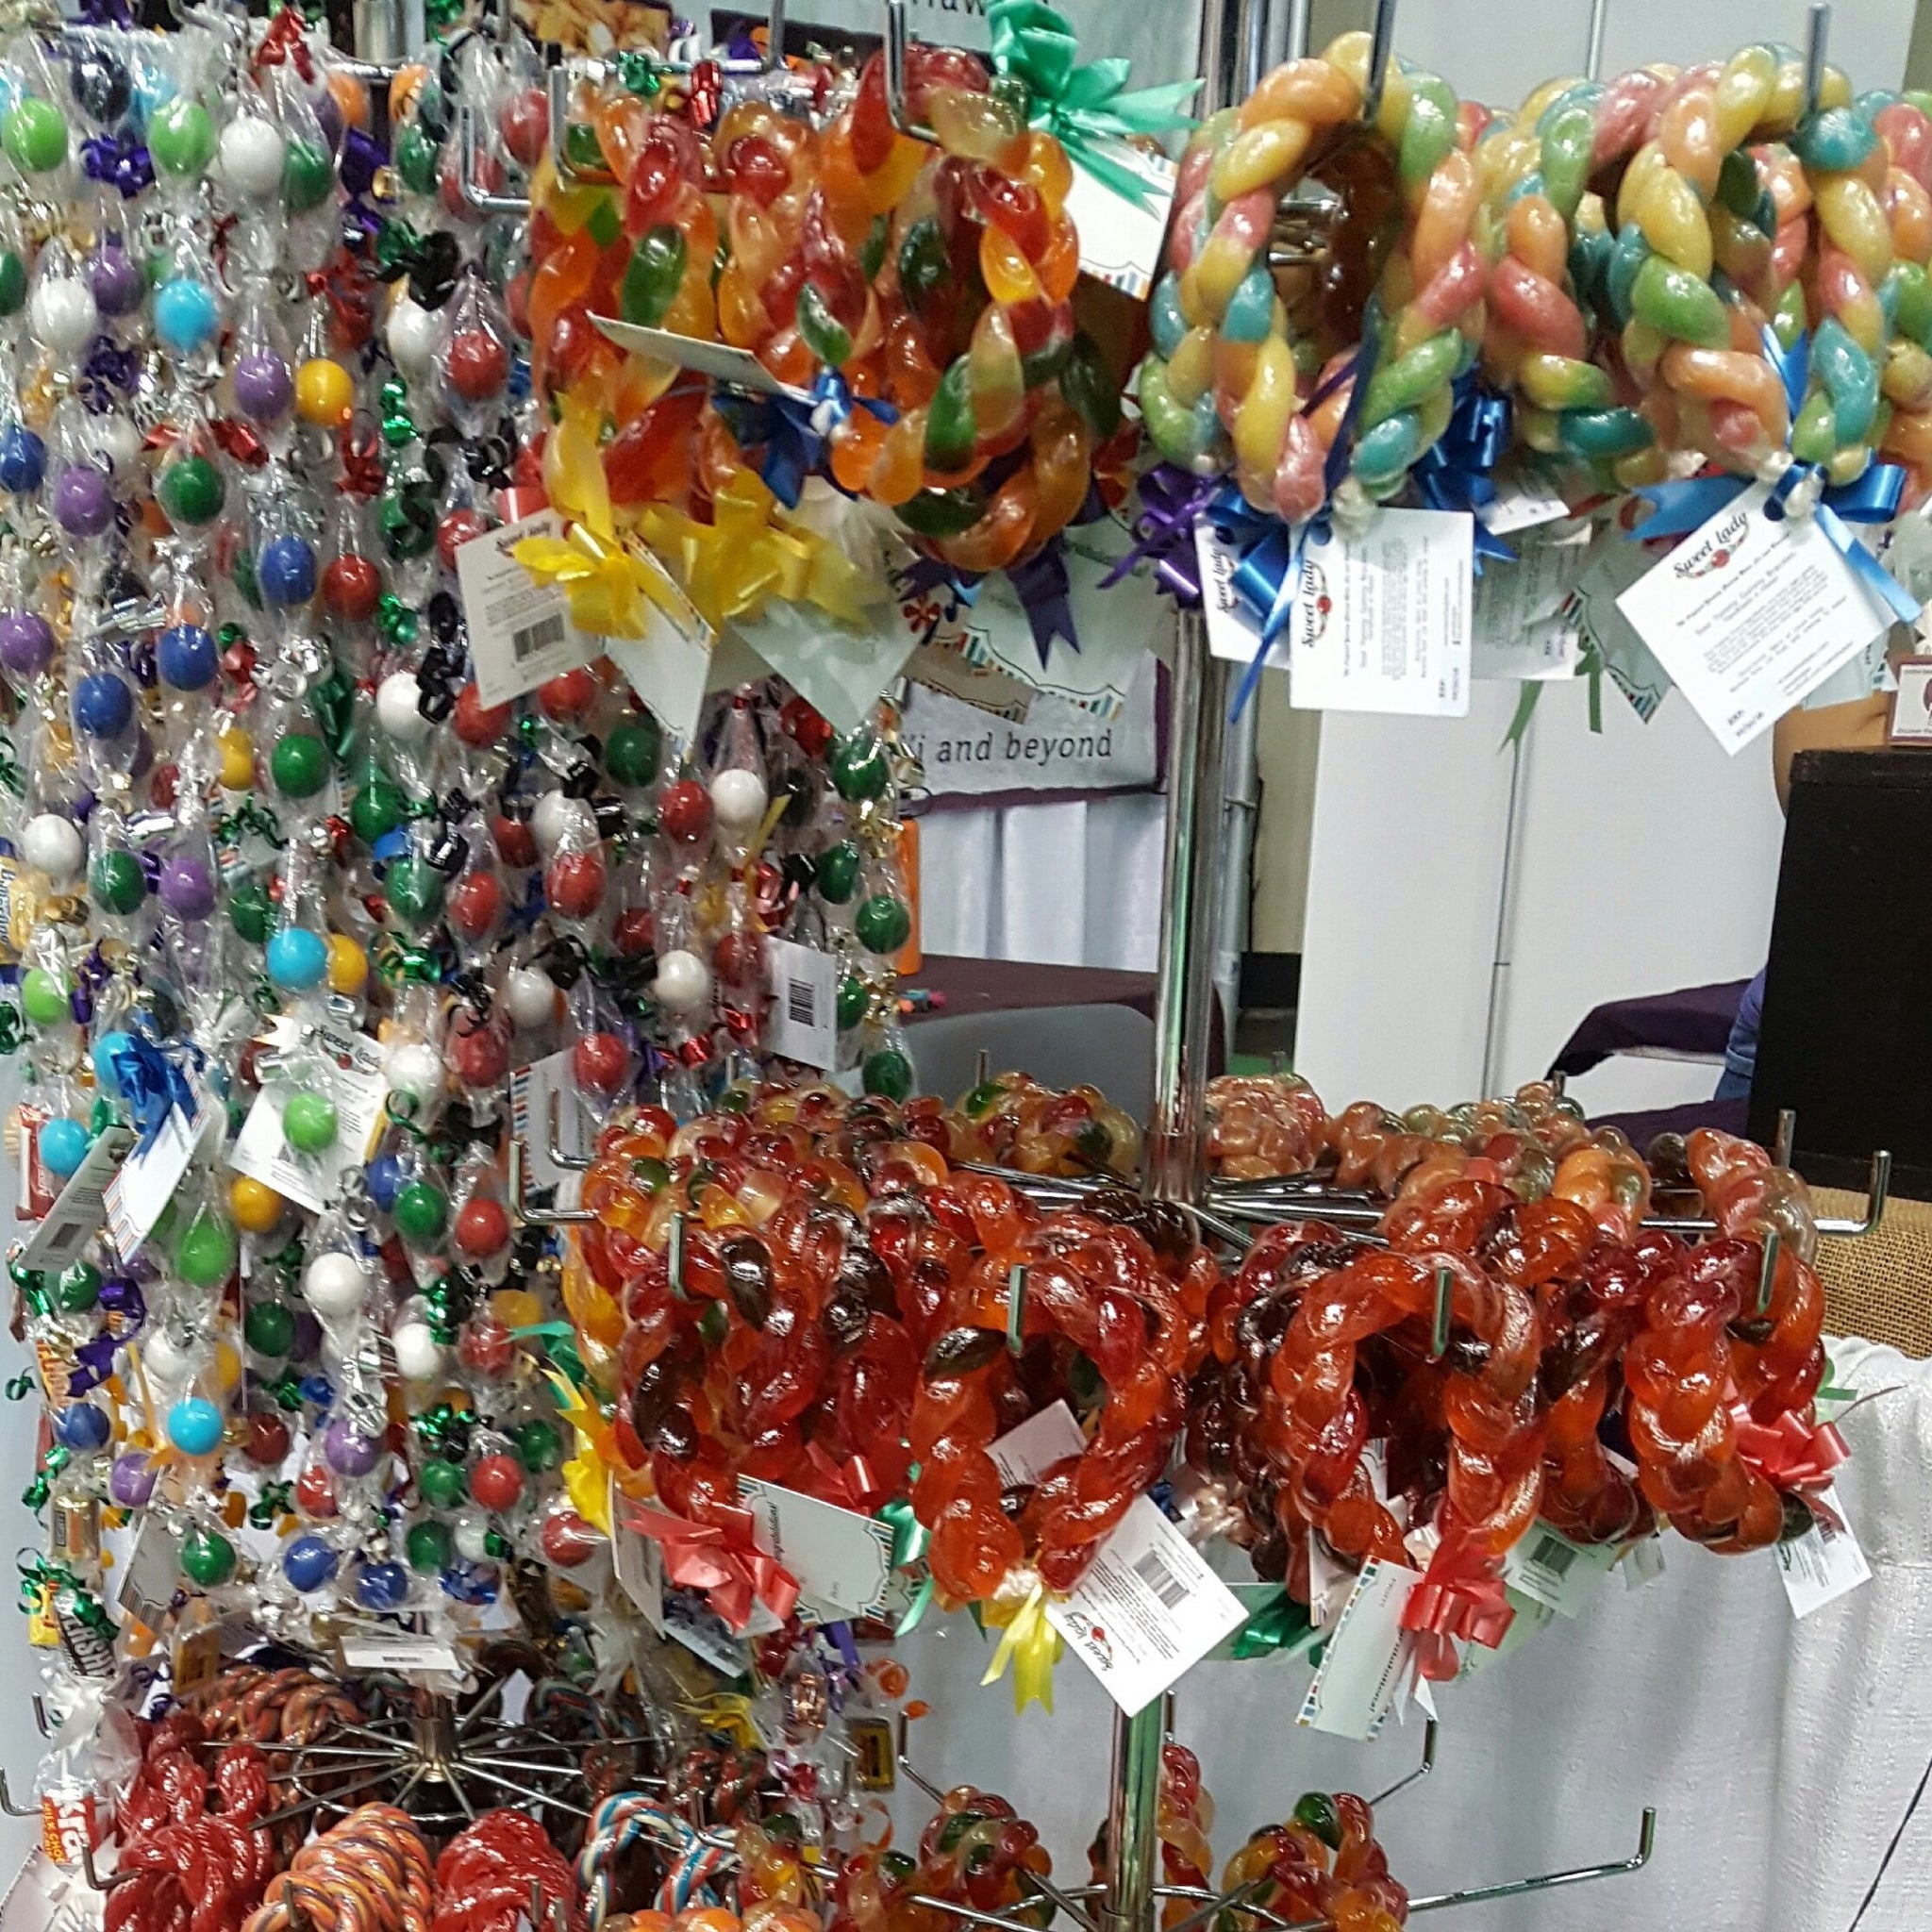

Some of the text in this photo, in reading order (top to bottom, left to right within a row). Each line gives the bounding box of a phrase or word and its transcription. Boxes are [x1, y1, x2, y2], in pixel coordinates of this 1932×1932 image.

[1673, 539, 1713, 579] Sweet
[1301, 599, 1316, 648] Sweet
[938, 732, 992, 762] and
[1007, 729, 1112, 765] beyond
